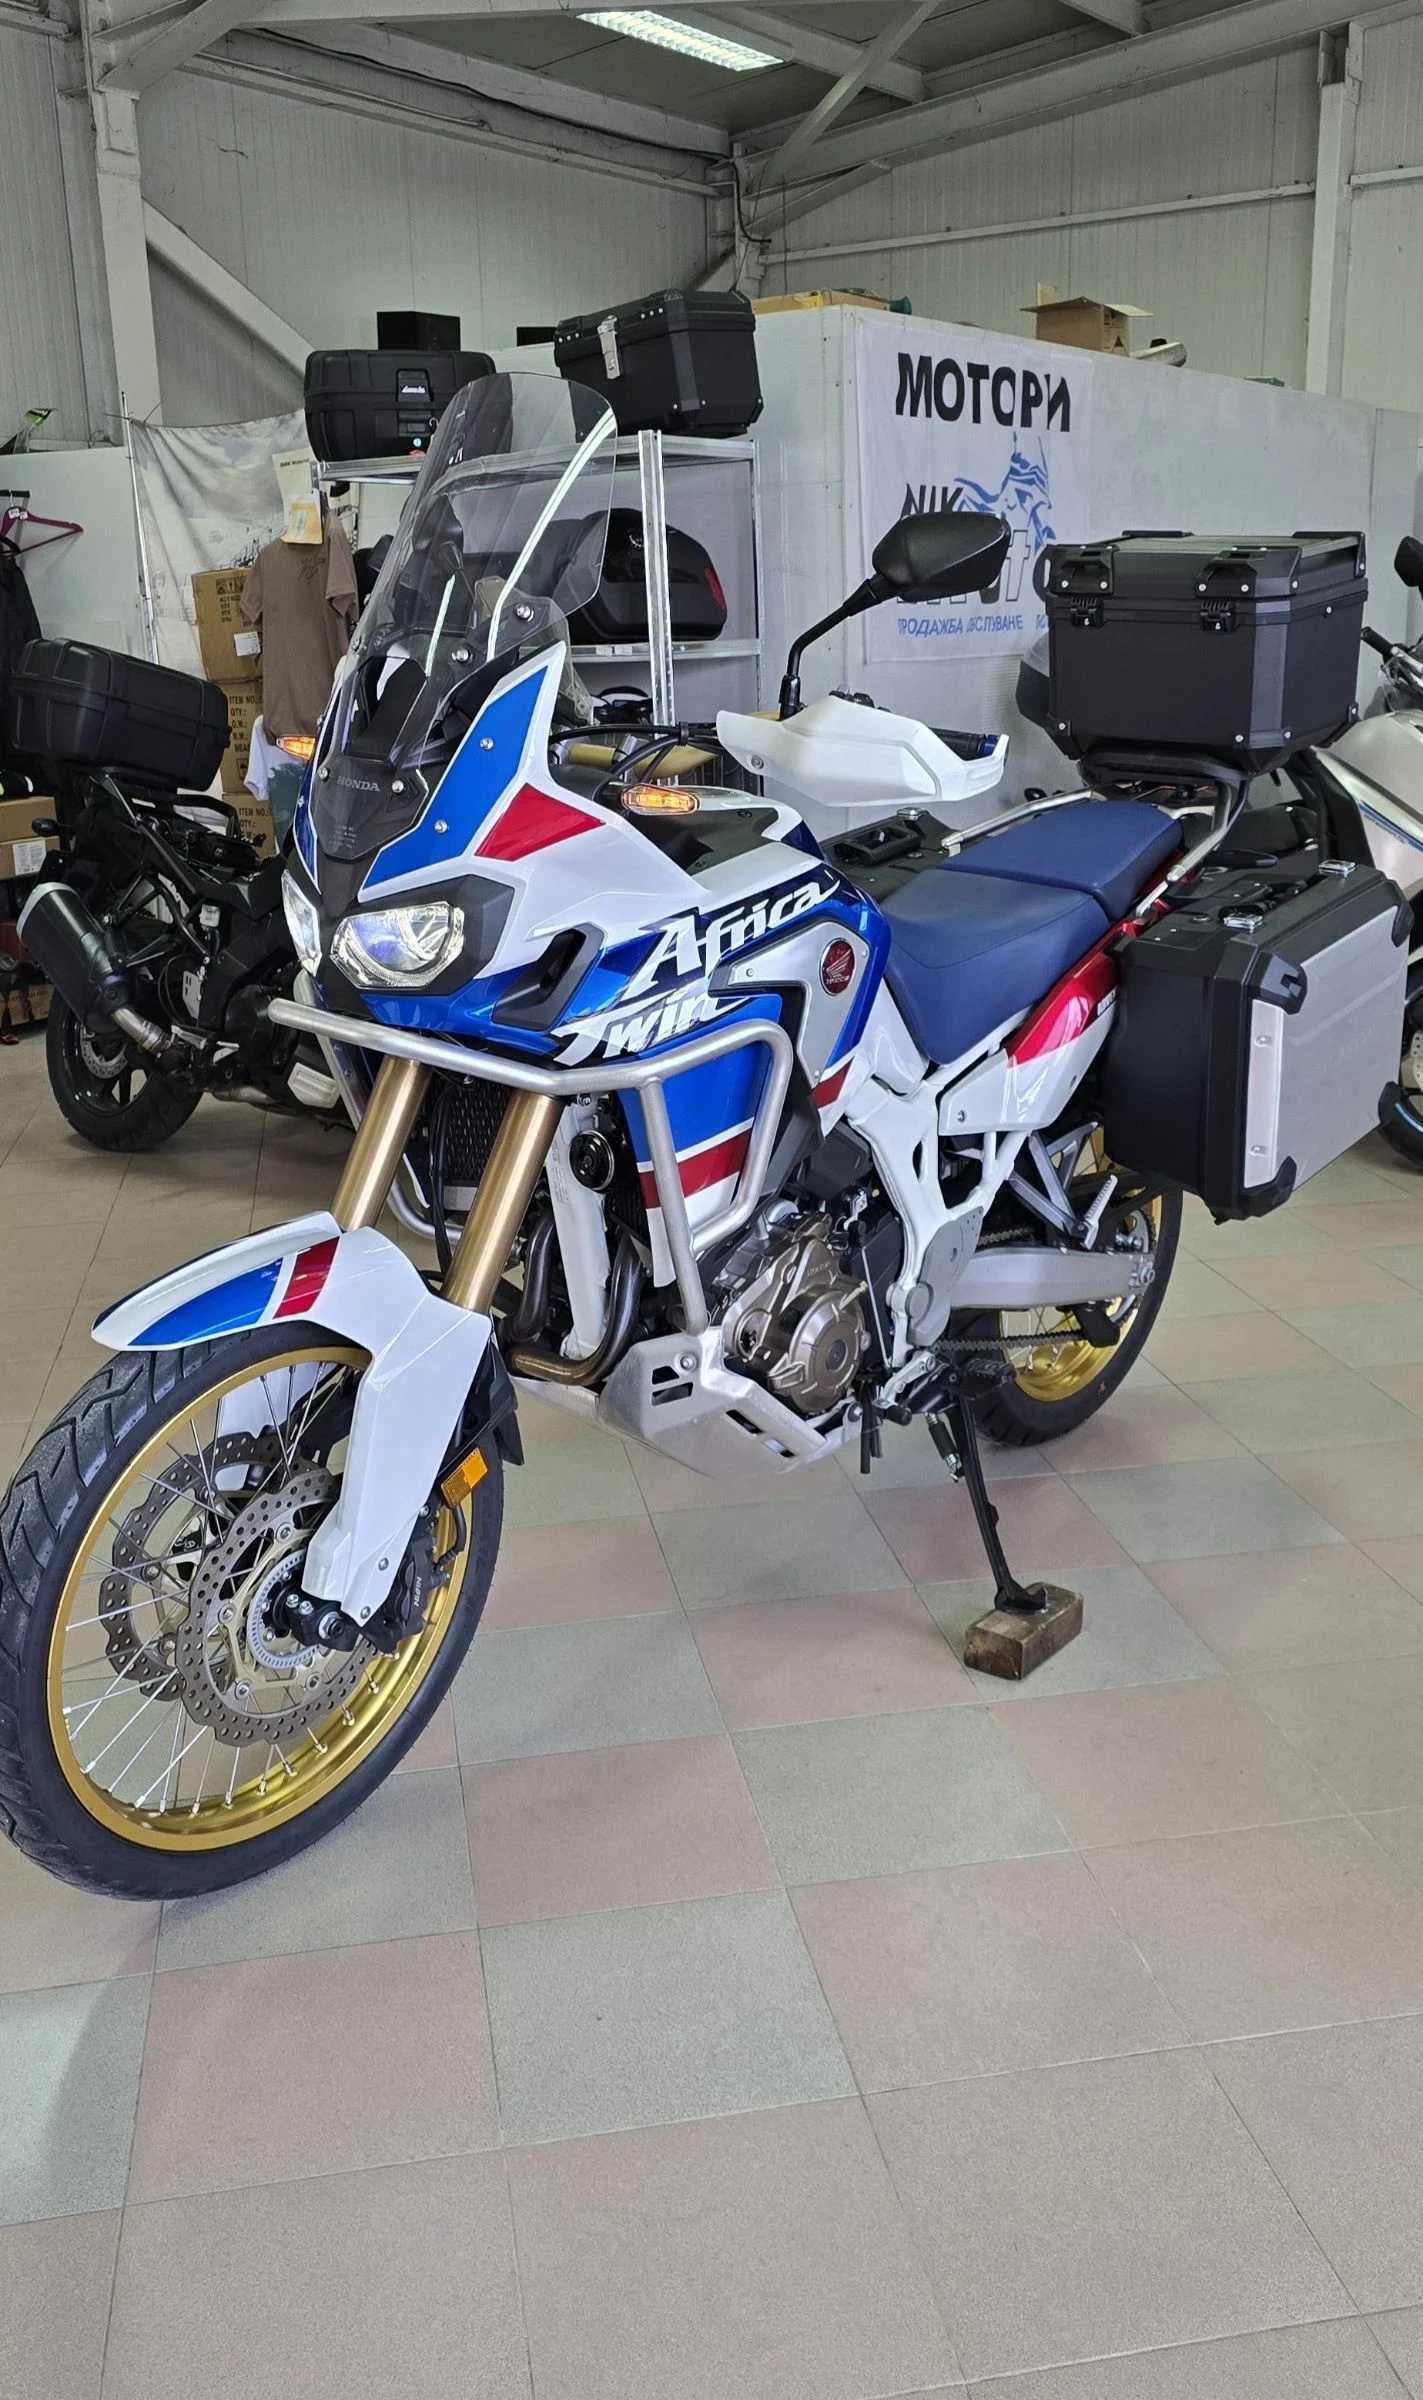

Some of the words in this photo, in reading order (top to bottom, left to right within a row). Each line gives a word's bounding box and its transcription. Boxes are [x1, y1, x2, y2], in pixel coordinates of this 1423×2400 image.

[896, 352, 1071, 433] МОТОРИ
[336, 775, 380, 792] HONDA
[618, 879, 841, 1001] Africa
[551, 988, 750, 1067] Twin
